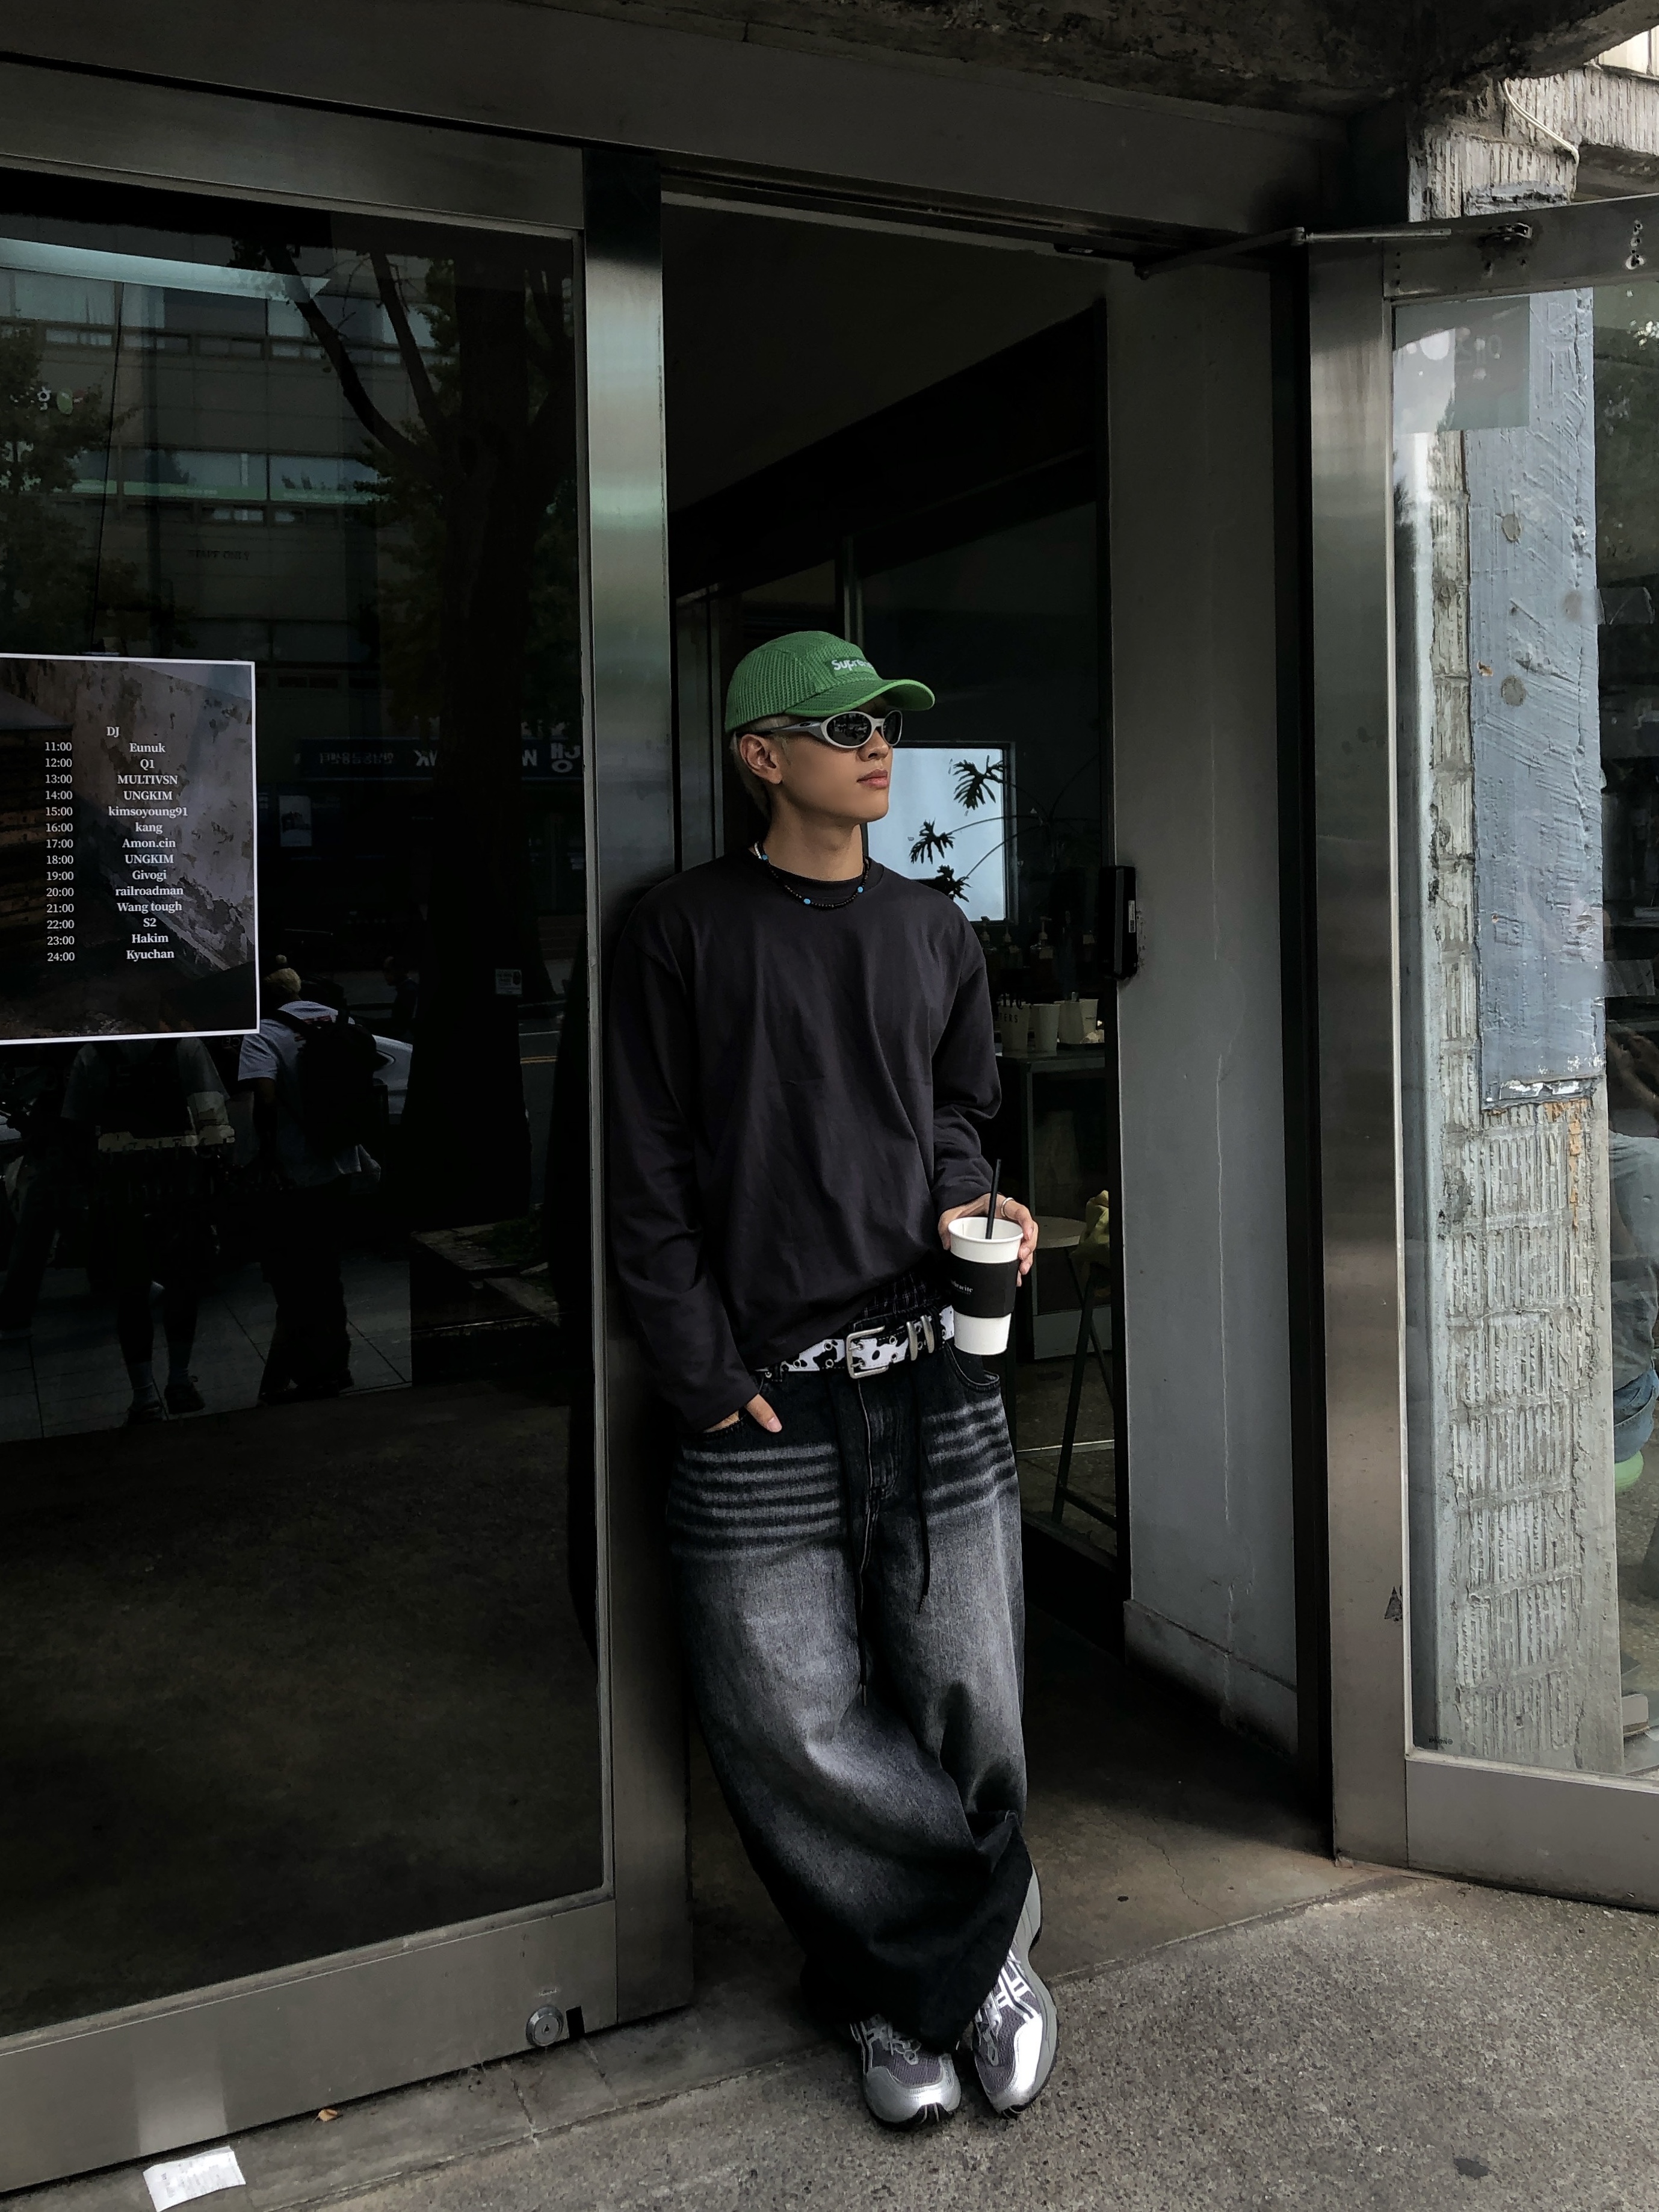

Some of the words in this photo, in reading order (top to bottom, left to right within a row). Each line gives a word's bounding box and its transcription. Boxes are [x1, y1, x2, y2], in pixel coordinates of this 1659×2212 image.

[107, 726, 120, 738] DJ
[45, 742, 72, 751] 11:00
[129, 742, 166, 753] Eunuk
[45, 758, 72, 767] 12:00
[140, 758, 155, 771] Q1
[45, 774, 73, 784] 13:00
[117, 775, 178, 785] MULTIVSN
[45, 790, 73, 800] 14:00
[123, 790, 173, 801] UNGKIM
[45, 807, 73, 816] 15:00
[108, 806, 188, 819] kimsoyoung91
[46, 823, 73, 832] 16:00
[135, 822, 163, 834] kang
[46, 838, 73, 848] 17:00
[122, 837, 176, 848] Amon.cin
[46, 855, 74, 864] 18:00
[125, 854, 174, 864] UNGKIM
[46, 871, 74, 881] 19:00
[132, 869, 167, 882] Givogi
[46, 887, 74, 897] 20:00
[115, 885, 184, 896] railroadman
[46, 903, 75, 913] 21:00
[116, 902, 149, 914] Wang
[150, 901, 182, 914] tough
[46, 919, 75, 929] 22:00
[143, 917, 157, 928] S2
[47, 935, 75, 946] 23:00
[131, 933, 169, 943] Hakim
[47, 952, 75, 962] 24:00
[126, 949, 175, 962] Kyuchan
